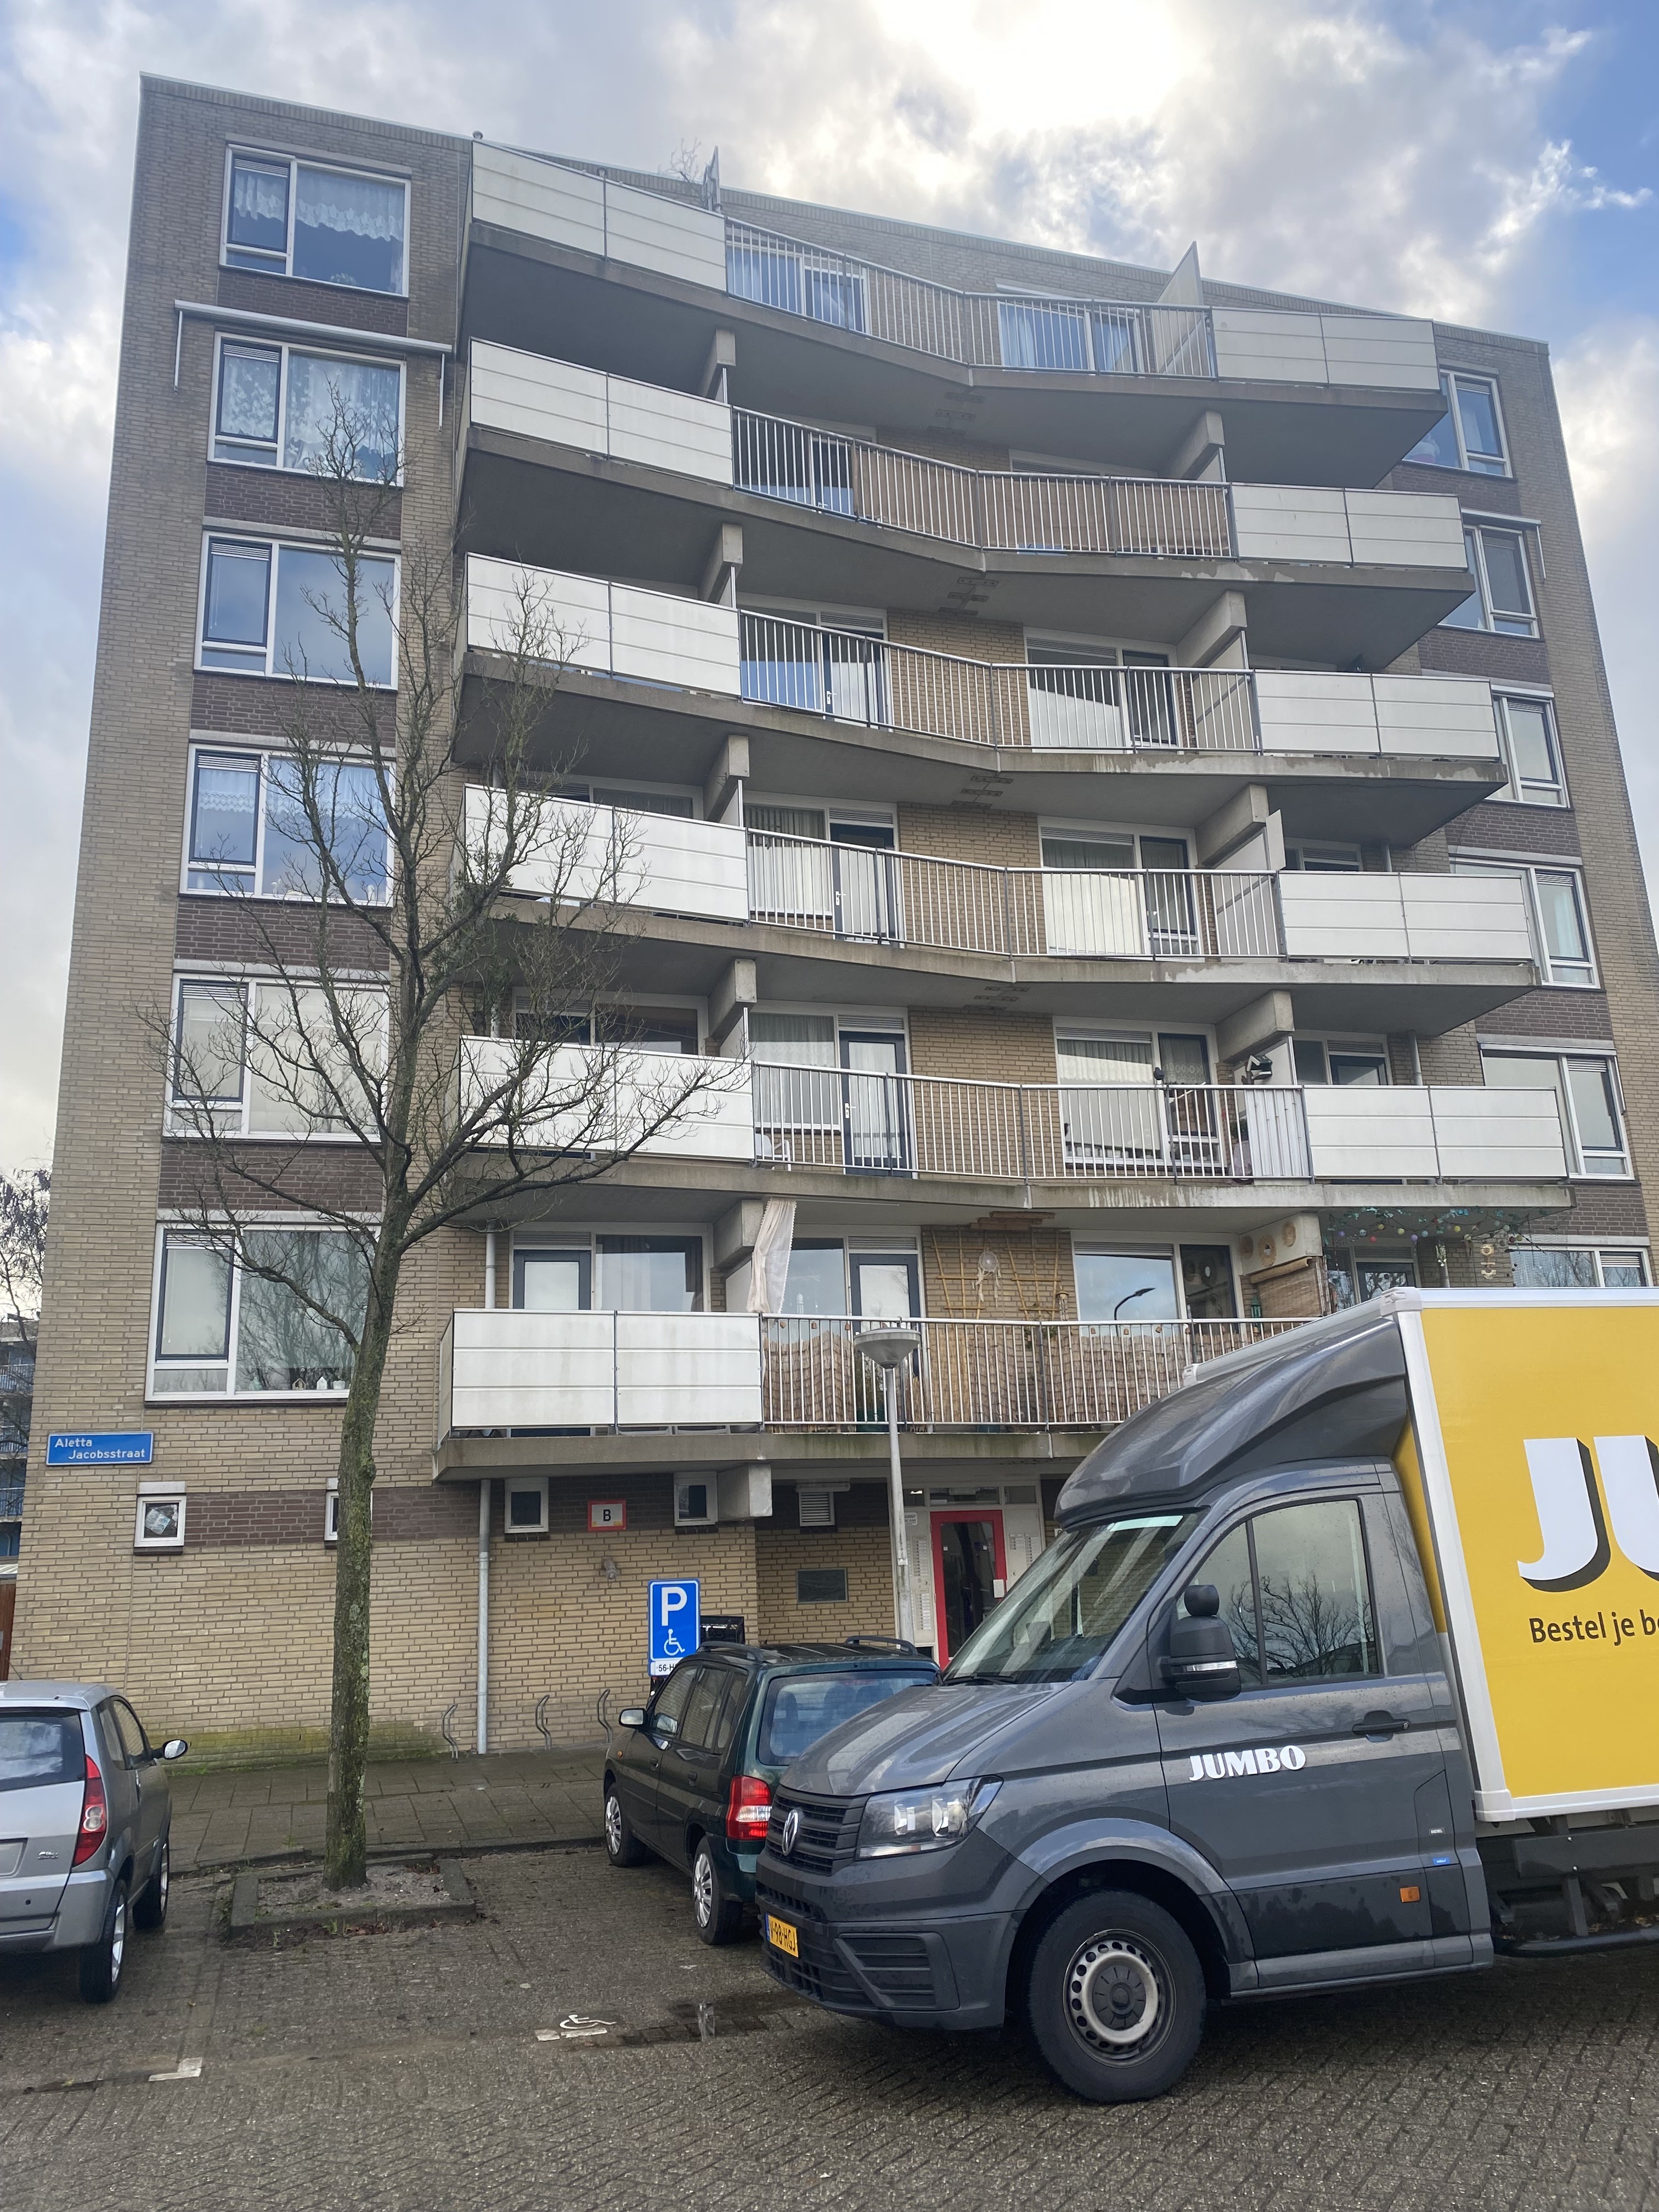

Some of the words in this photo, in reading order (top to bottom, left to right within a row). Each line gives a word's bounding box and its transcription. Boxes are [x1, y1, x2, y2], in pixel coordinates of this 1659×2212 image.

[54, 1438, 93, 1448] Aletta
[68, 1448, 145, 1459] Jacobsstraat
[603, 1509, 611, 1521] B
[661, 1587, 687, 1626] P
[1528, 1611, 1607, 1644] Bestel
[1611, 1612, 1635, 1646] je
[1639, 1609, 1659, 1636] b
[1189, 1745, 1306, 1781] JUMBO
